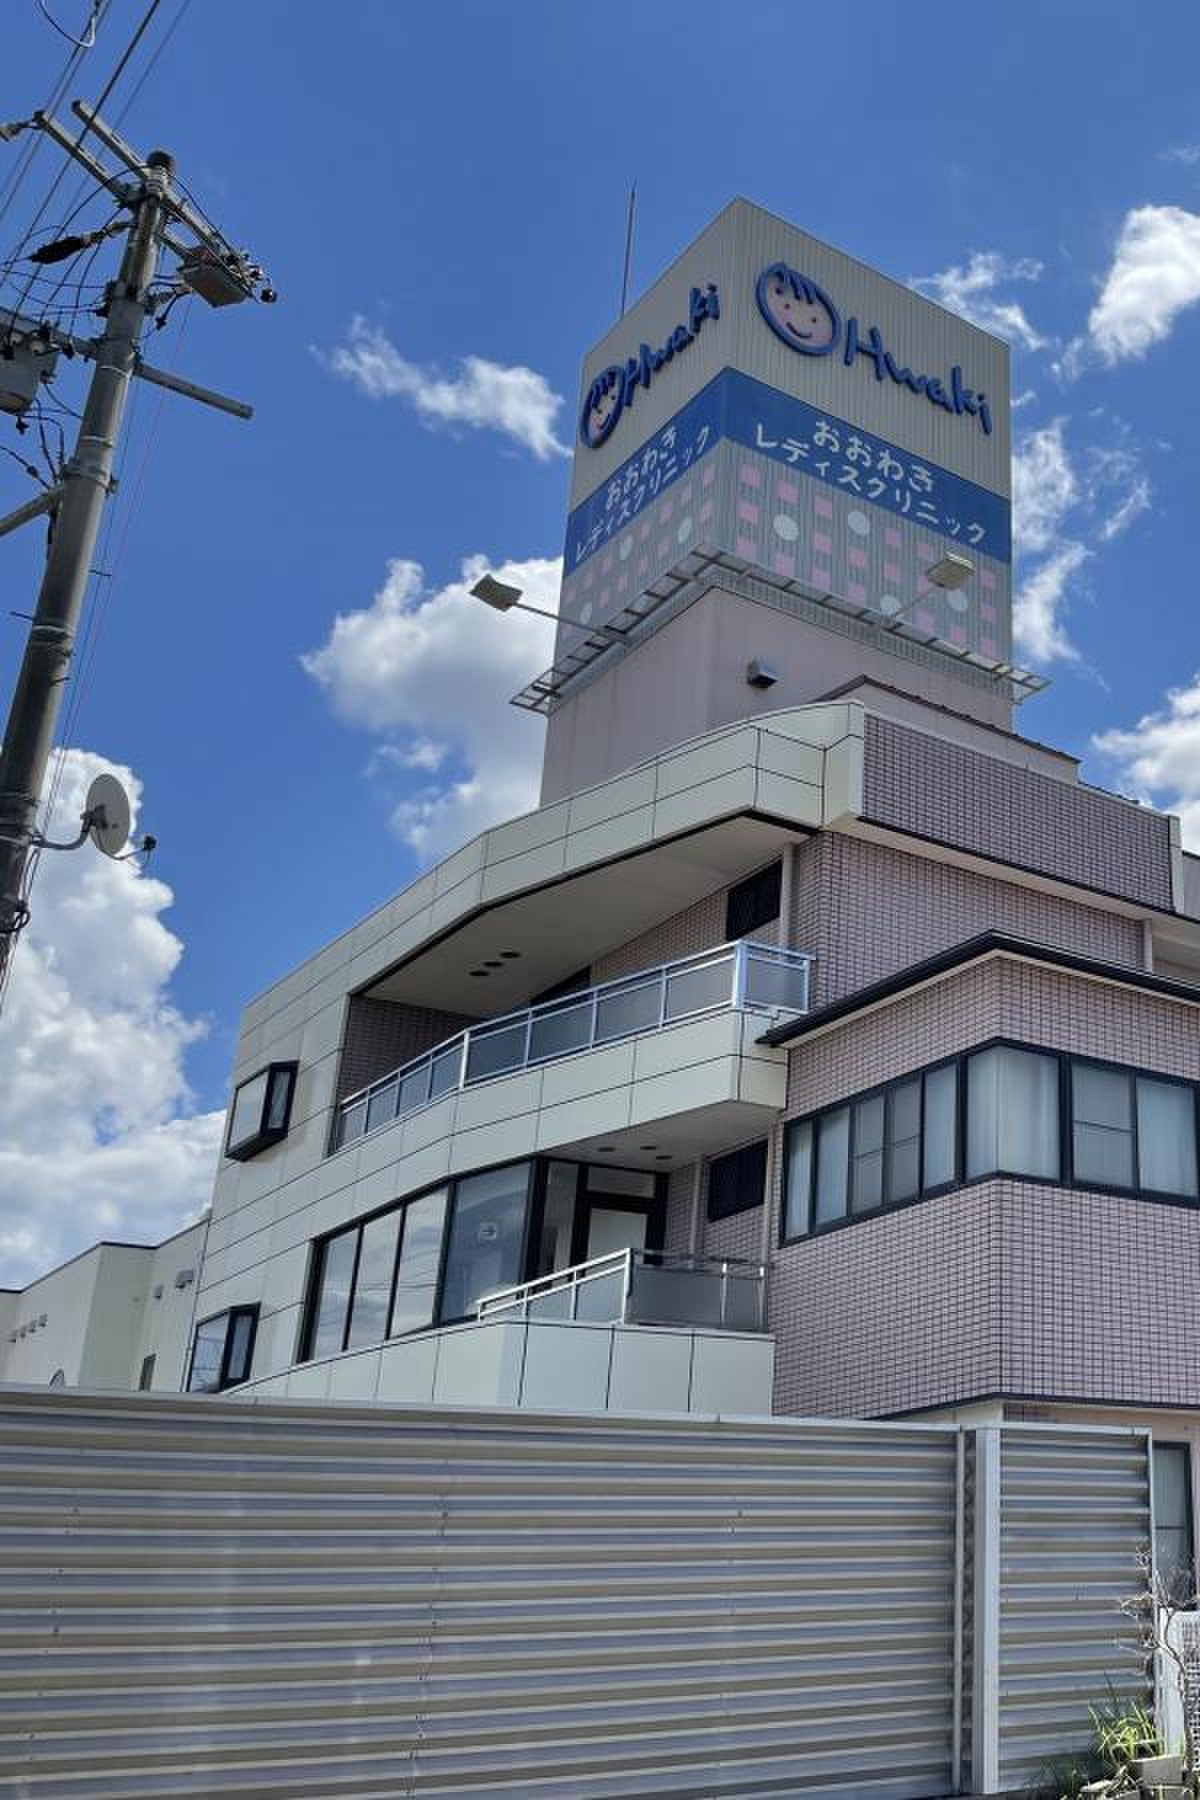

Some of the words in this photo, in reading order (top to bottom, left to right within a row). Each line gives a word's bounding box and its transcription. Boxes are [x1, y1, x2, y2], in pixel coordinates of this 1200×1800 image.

[606, 426, 677, 510] おおわき
[756, 423, 986, 543] レディスクリニック
[813, 421, 932, 492] おおわき
